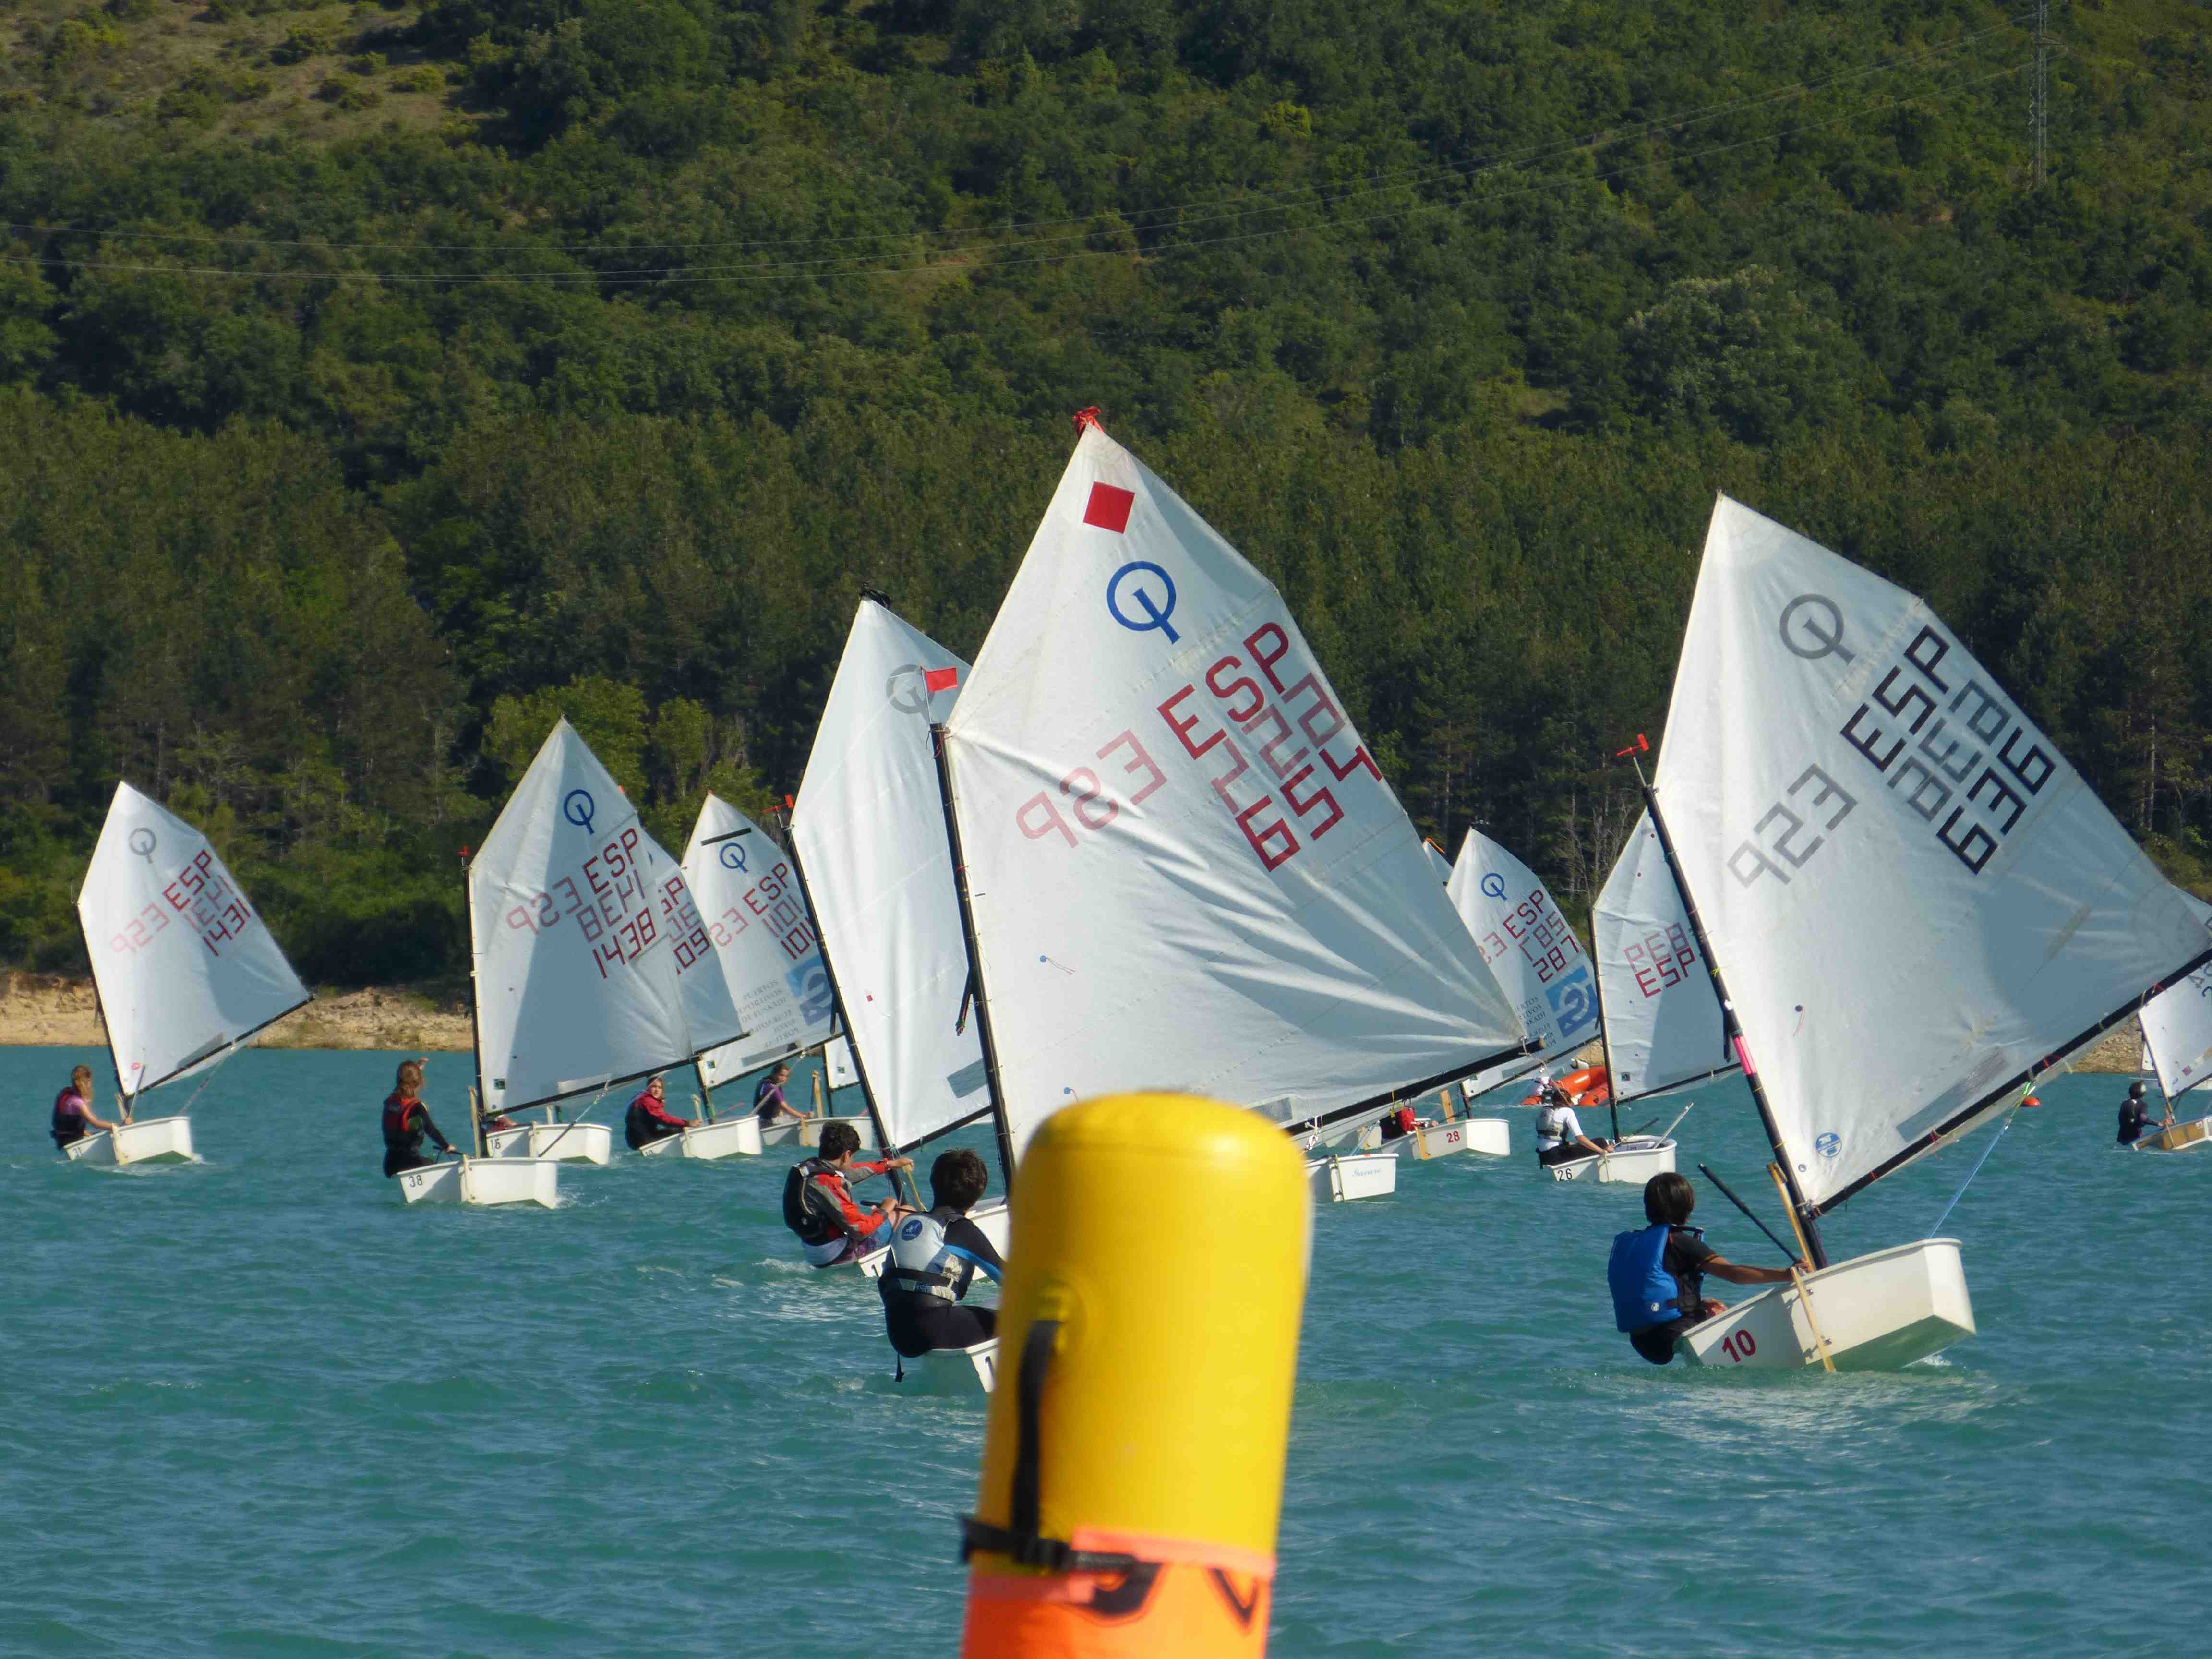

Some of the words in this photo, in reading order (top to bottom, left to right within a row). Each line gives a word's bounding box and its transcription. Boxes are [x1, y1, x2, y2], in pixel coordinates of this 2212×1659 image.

[1156, 621, 1290, 761] ESP
[1839, 624, 1950, 773] ESP
[1235, 745, 1382, 873] 654
[1936, 726, 2057, 875] 636
[162, 849, 212, 912] ESP
[582, 828, 638, 895] ESP
[742, 862, 788, 916] ESP
[1502, 889, 1544, 939] ESP
[203, 897, 250, 957] 1431
[592, 907, 657, 979] 1438
[673, 927, 710, 975] 09
[1532, 935, 1580, 984] 287
[1635, 947, 1696, 999] ESP
[1446, 1130, 1460, 1143] 28
[409, 1175, 423, 1188] 38
[1557, 1168, 1573, 1181] 26
[1722, 1329, 1756, 1363] 10
